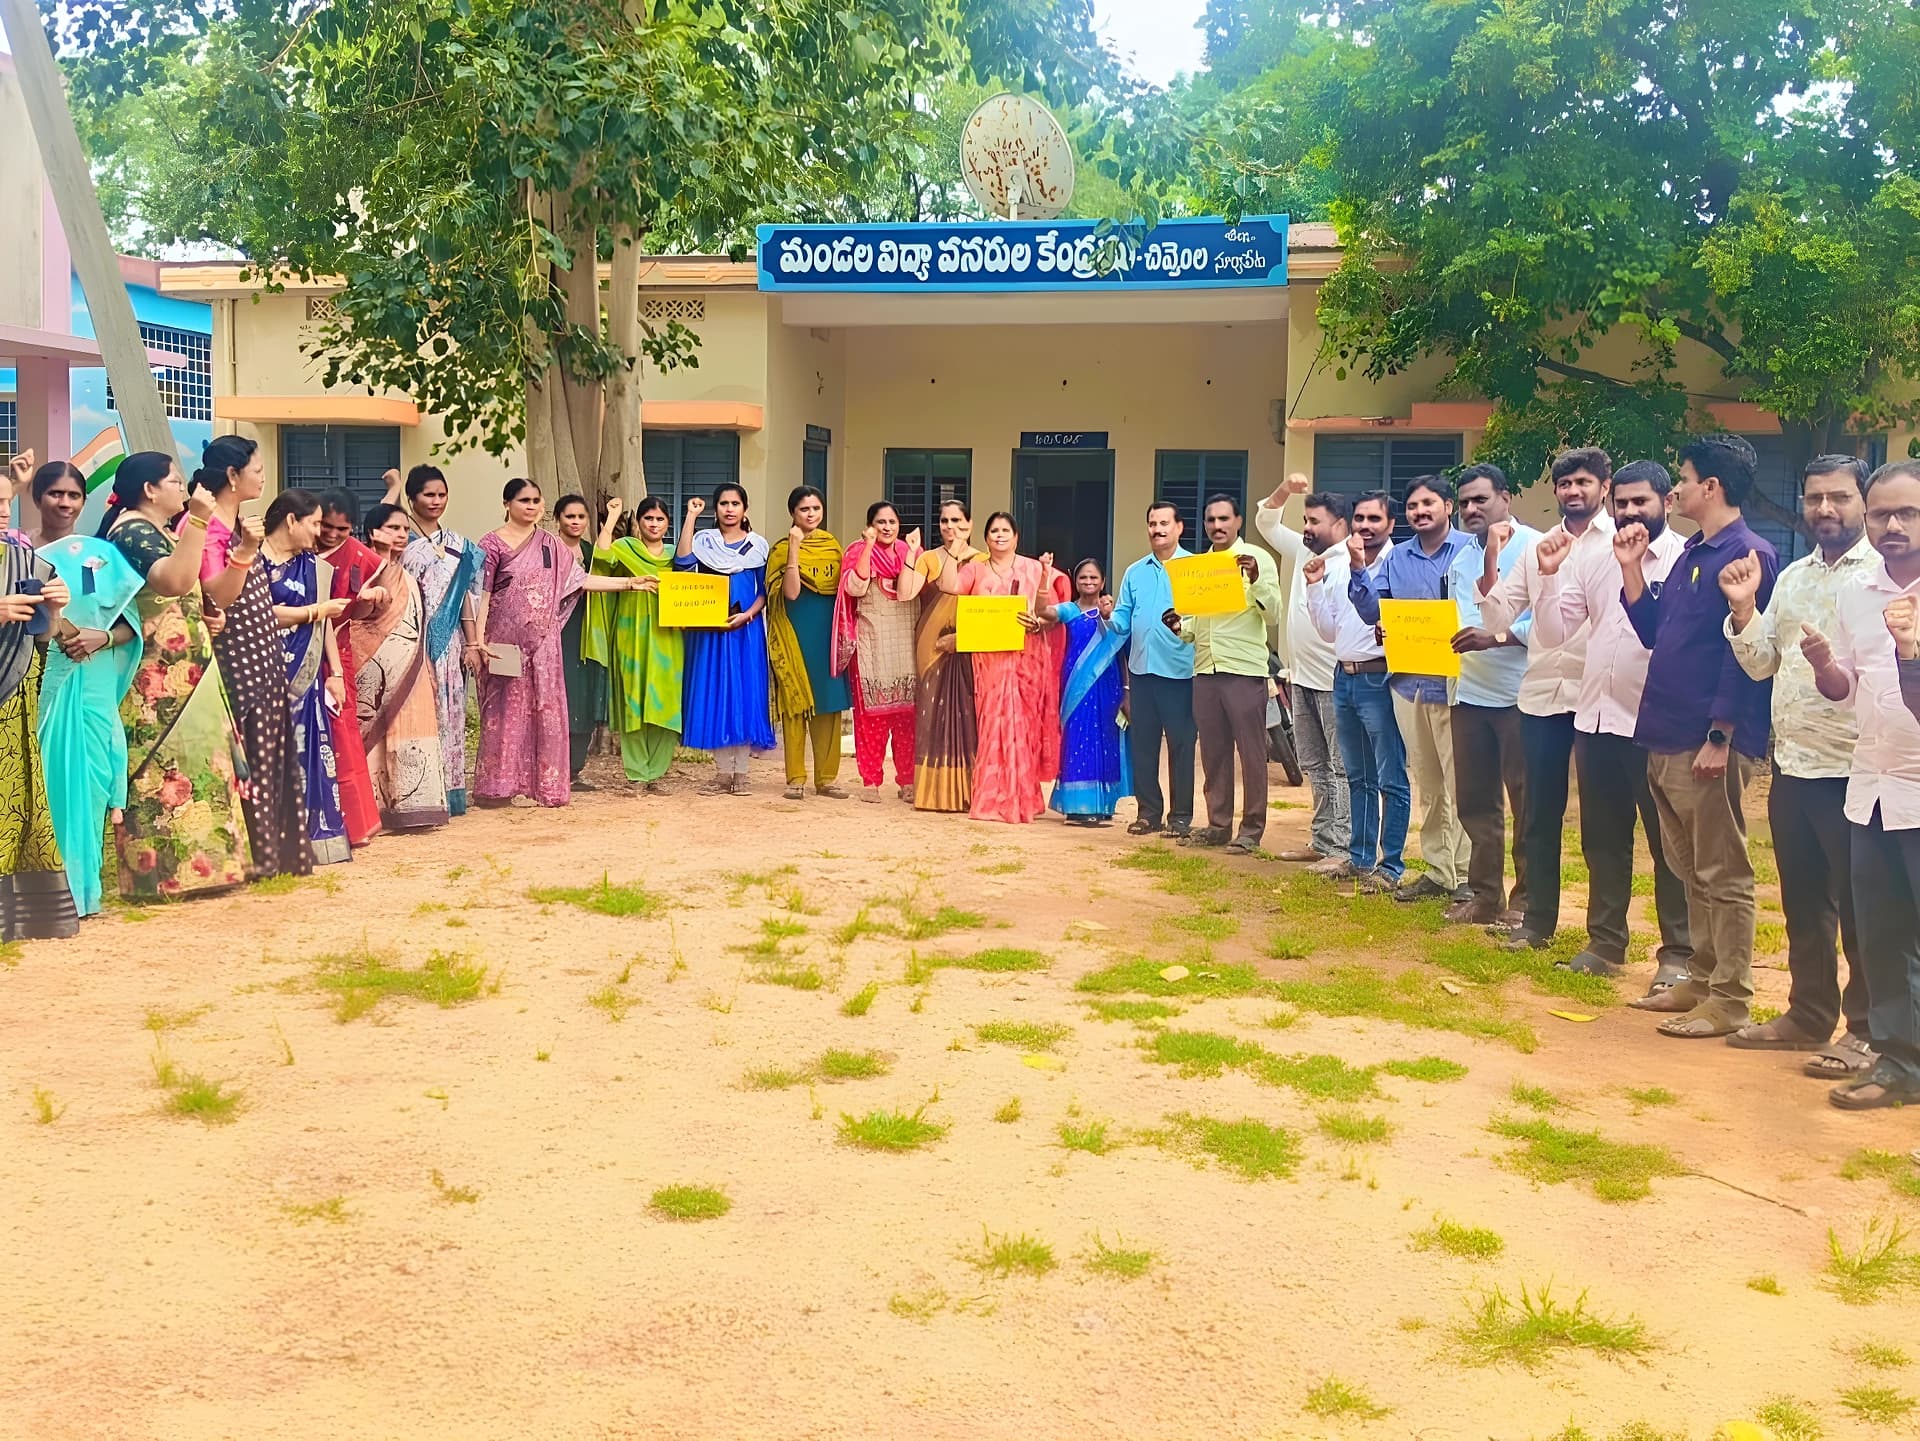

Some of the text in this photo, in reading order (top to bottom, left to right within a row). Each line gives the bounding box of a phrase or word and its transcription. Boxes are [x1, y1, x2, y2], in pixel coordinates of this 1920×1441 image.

[779, 235, 874, 273] మండల
[877, 239, 933, 282] విద్యా
[937, 235, 1032, 273] వనరుల
